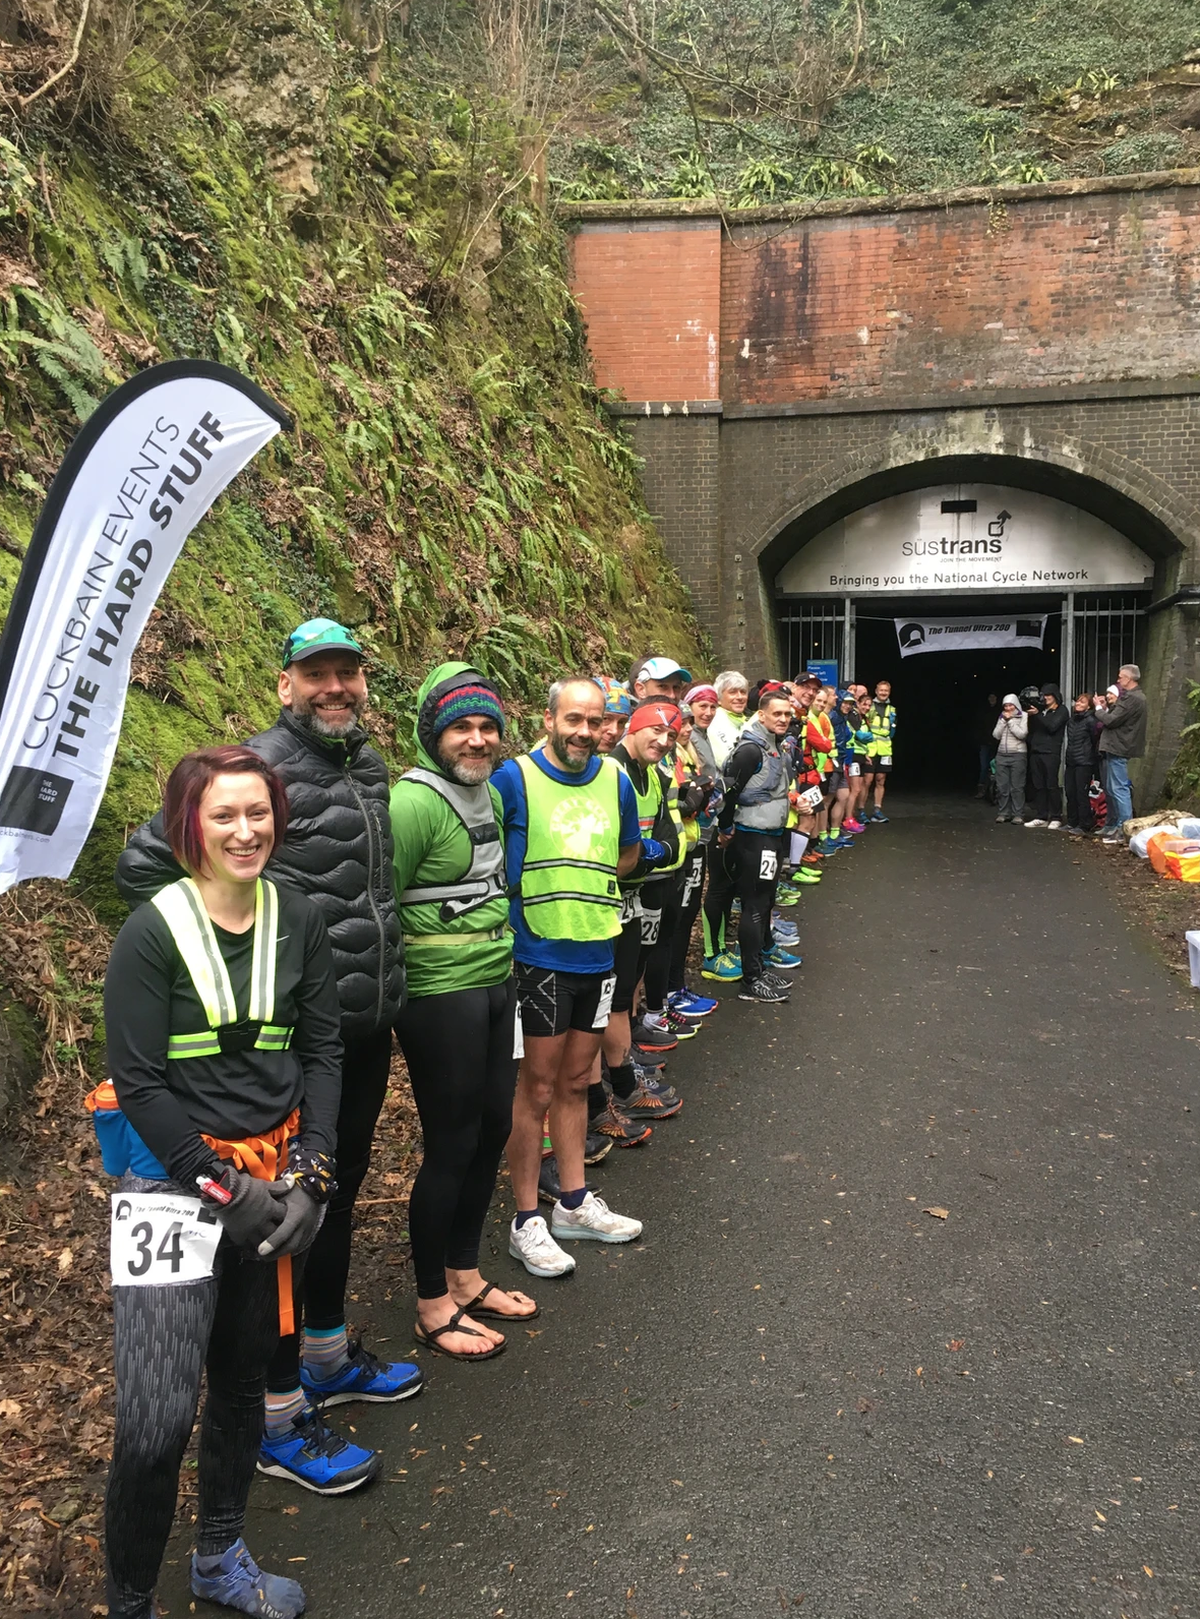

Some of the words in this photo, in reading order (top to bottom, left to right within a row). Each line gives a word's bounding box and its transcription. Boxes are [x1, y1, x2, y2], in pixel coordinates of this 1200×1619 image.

[23, 550, 115, 750] COCKBAIN
[102, 415, 180, 546] EVENTS
[51, 675, 101, 759] THE
[87, 539, 154, 667] HARD
[149, 410, 227, 530] STUFF
[829, 575, 880, 587] Bringing
[883, 576, 905, 587] you
[909, 574, 929, 584] the
[934, 572, 988, 583] National
[992, 570, 1028, 584] Cycle
[1032, 569, 1089, 581] Network
[928, 627, 943, 635] The
[945, 624, 972, 634] Tunnel
[972, 623, 994, 632] Ultra
[994, 623, 1011, 632] 200
[760, 860, 775, 877] 24
[641, 920, 660, 942] 28
[127, 1220, 184, 1277] 34
